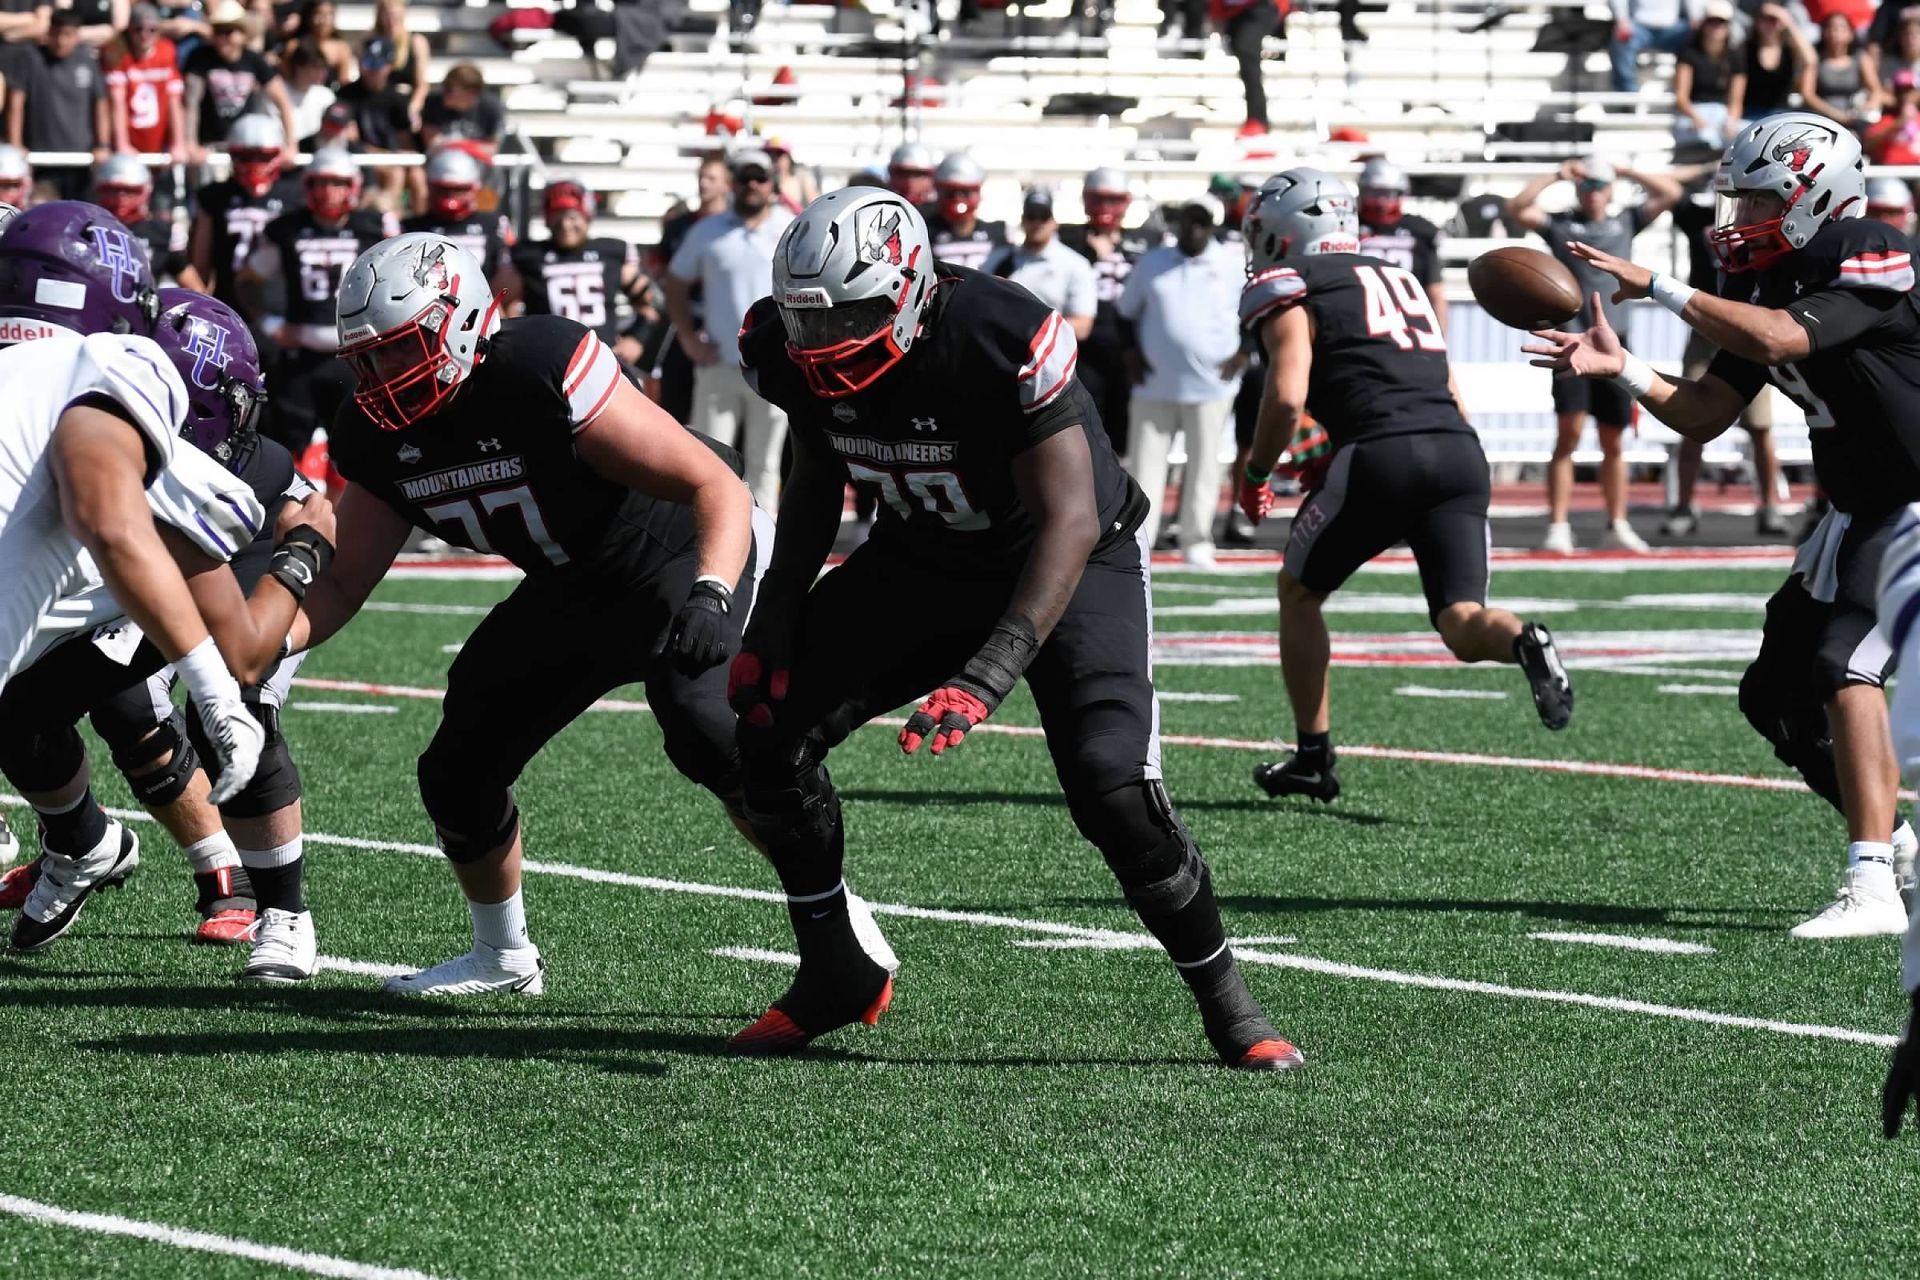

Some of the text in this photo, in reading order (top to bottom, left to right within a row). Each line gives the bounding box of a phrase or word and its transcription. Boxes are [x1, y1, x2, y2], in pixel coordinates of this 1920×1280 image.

[130, 83, 159, 129] 9
[301, 252, 357, 300] 67
[786, 293, 824, 304] Riddell
[547, 275, 606, 326] 65
[1353, 265, 1447, 352] 49
[832, 435, 953, 463] MOUNTAINEERS
[401, 456, 524, 500] MOUNTAINEERS
[846, 460, 992, 532] 70
[422, 484, 571, 567] 77
